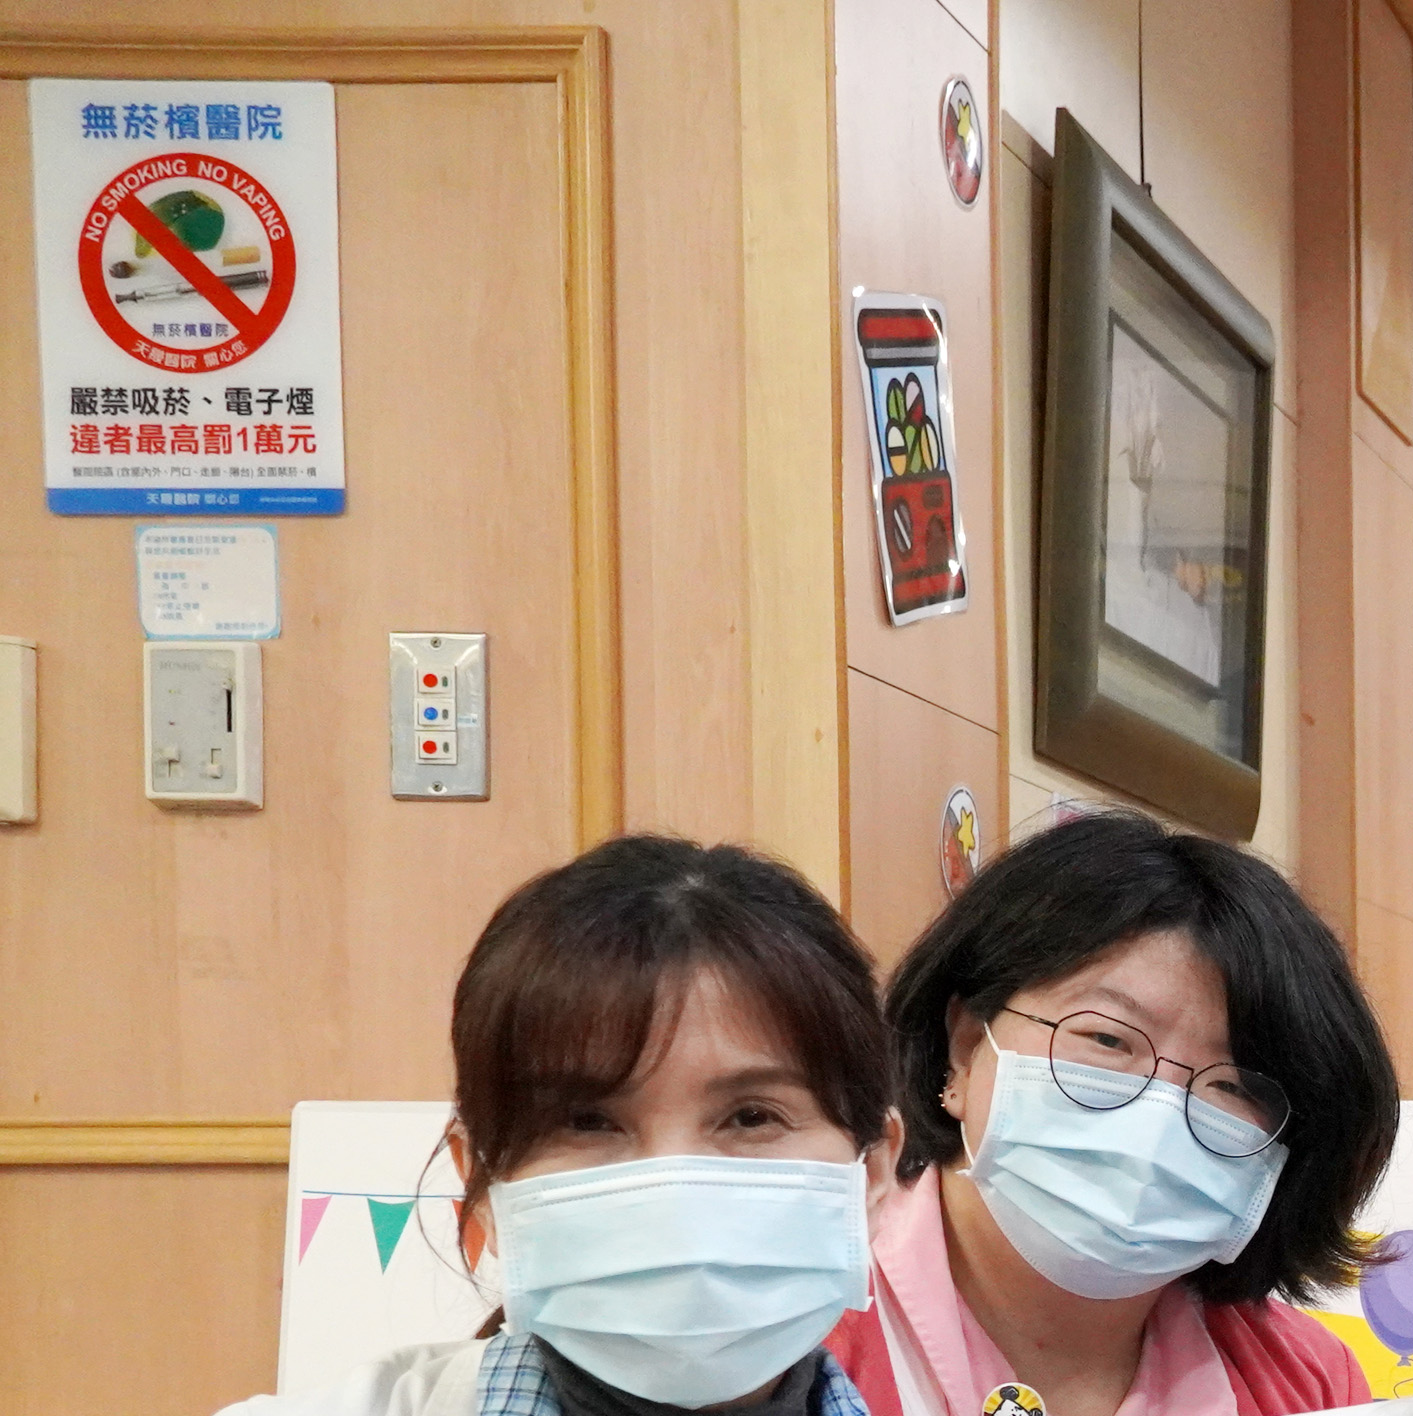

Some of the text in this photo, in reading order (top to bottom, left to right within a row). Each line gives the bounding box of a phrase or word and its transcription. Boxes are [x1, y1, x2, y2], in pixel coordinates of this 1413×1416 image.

[81, 103, 283, 140] 無菸檳醫院
[85, 159, 285, 242] NO SMOKING NO VAPING
[70, 387, 315, 416] 嚴禁吸菸、電子煙
[69, 424, 317, 455] 違者最高罰1萬元
